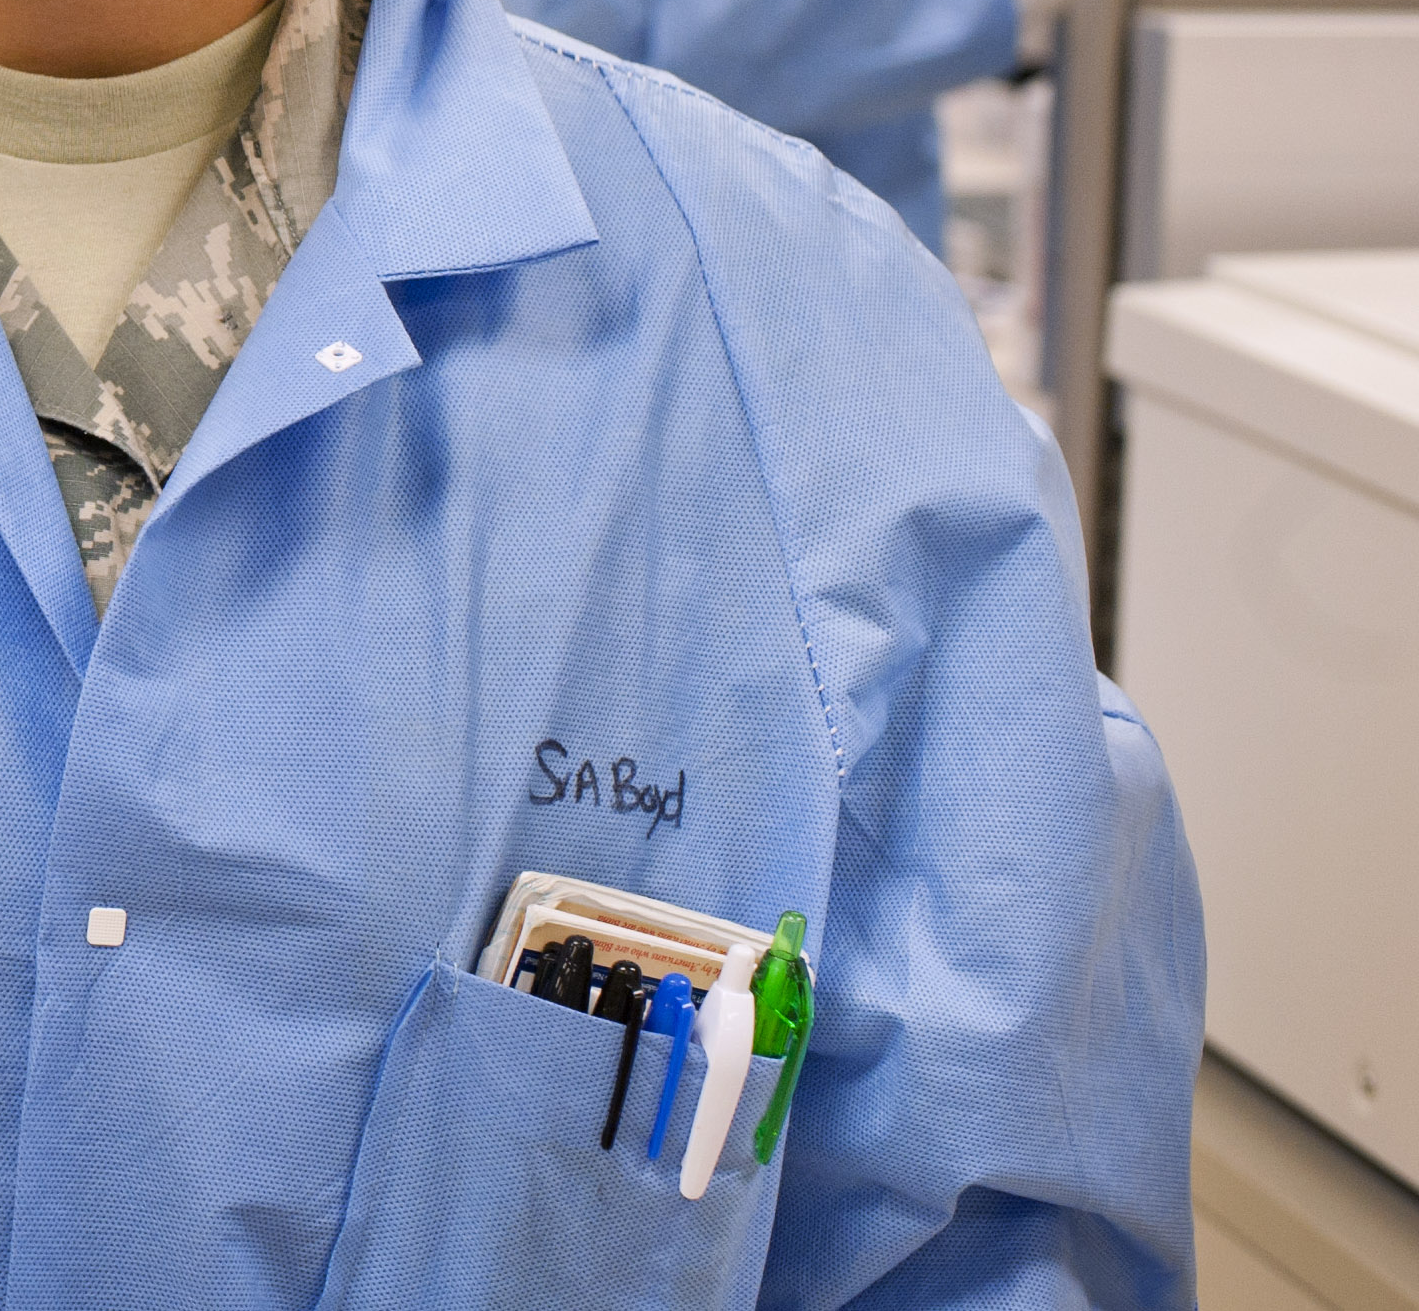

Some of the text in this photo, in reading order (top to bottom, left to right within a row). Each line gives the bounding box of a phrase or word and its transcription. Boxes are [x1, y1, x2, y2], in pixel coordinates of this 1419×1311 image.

[612, 756, 686, 839] Boyd
[615, 944, 630, 954] are
[630, 948, 650, 960] who
[651, 949, 701, 972] Americans
